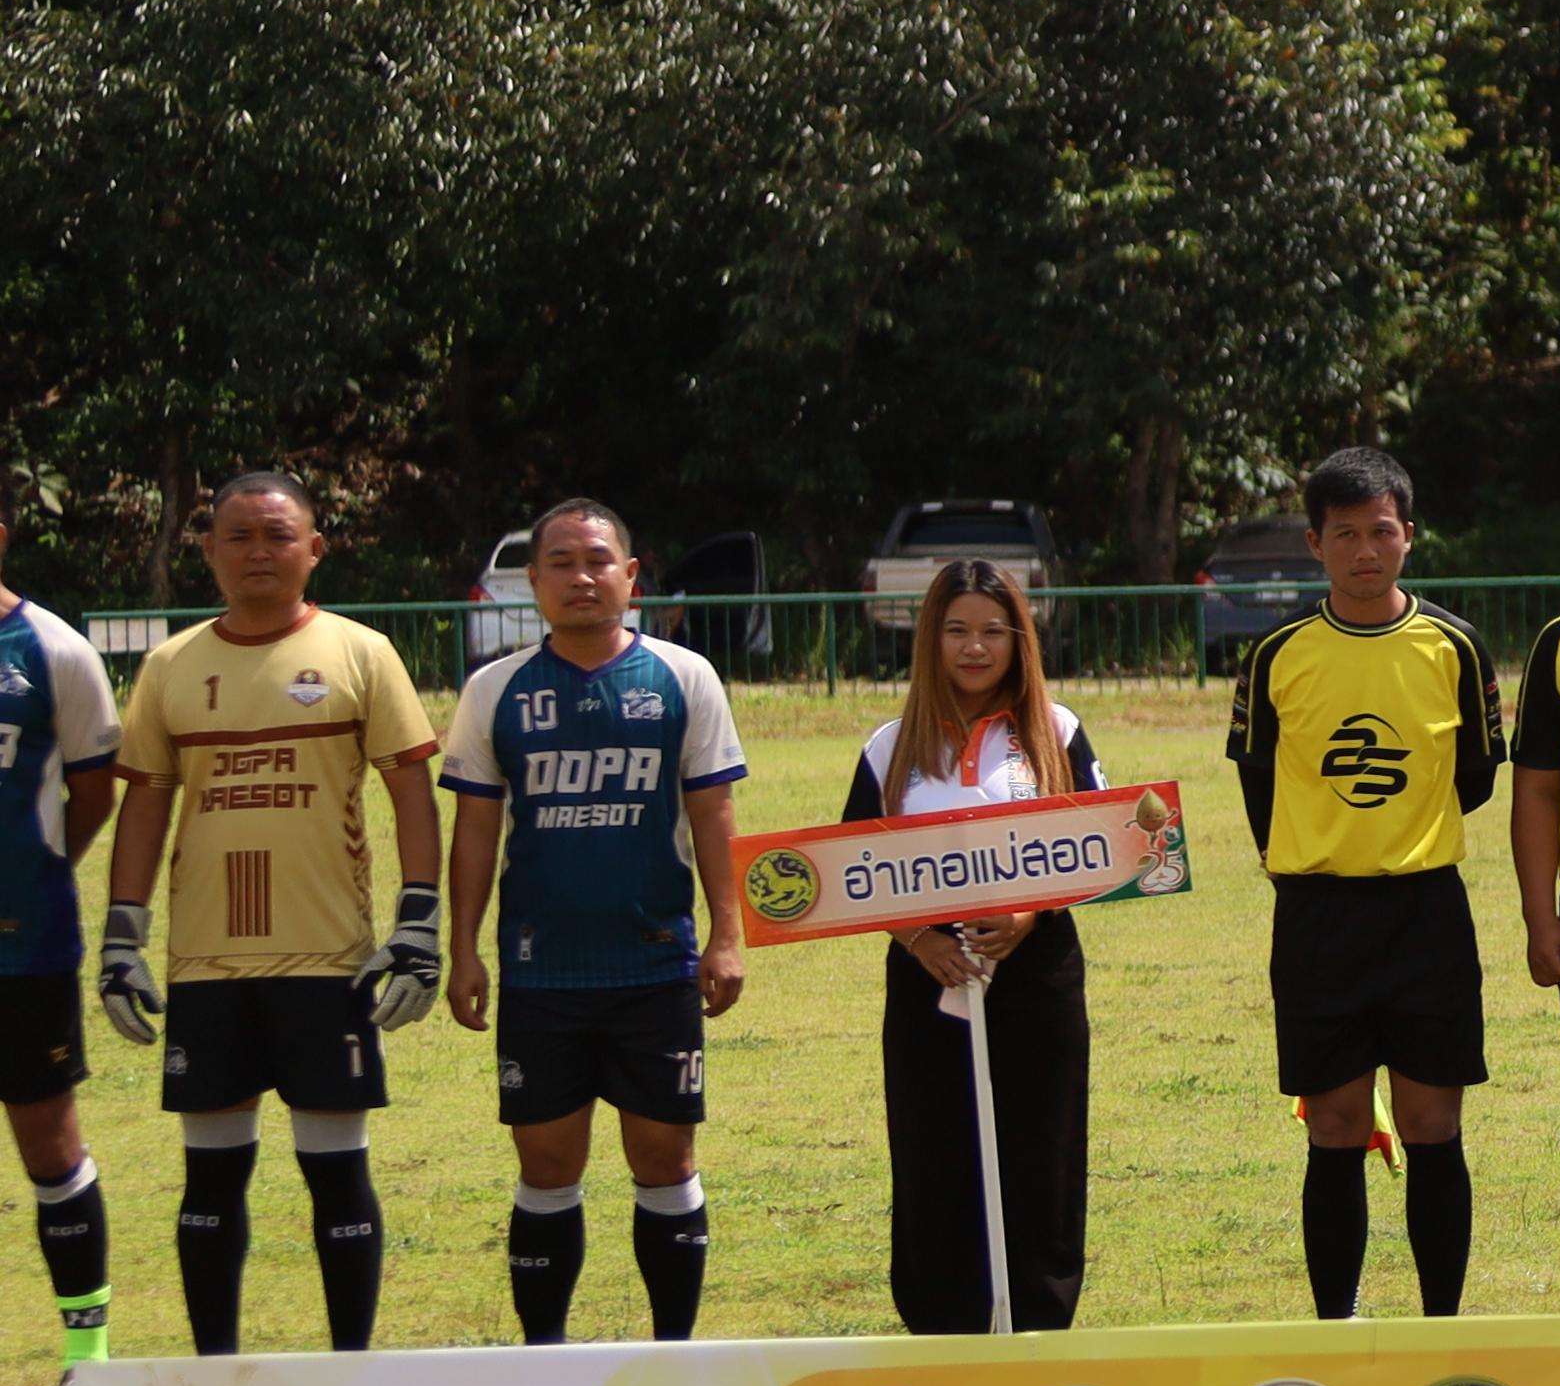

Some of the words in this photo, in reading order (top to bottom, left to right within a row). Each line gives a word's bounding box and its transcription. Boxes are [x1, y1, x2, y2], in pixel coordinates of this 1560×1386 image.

[205, 675, 221, 710] 1
[514, 688, 559, 733] 10
[525, 747, 662, 797] DOPA
[536, 803, 645, 829] MAESOT
[844, 831, 1112, 901] อำเภอแม่สอด
[180, 1213, 220, 1227] EGO
[331, 1222, 373, 1239] EGO
